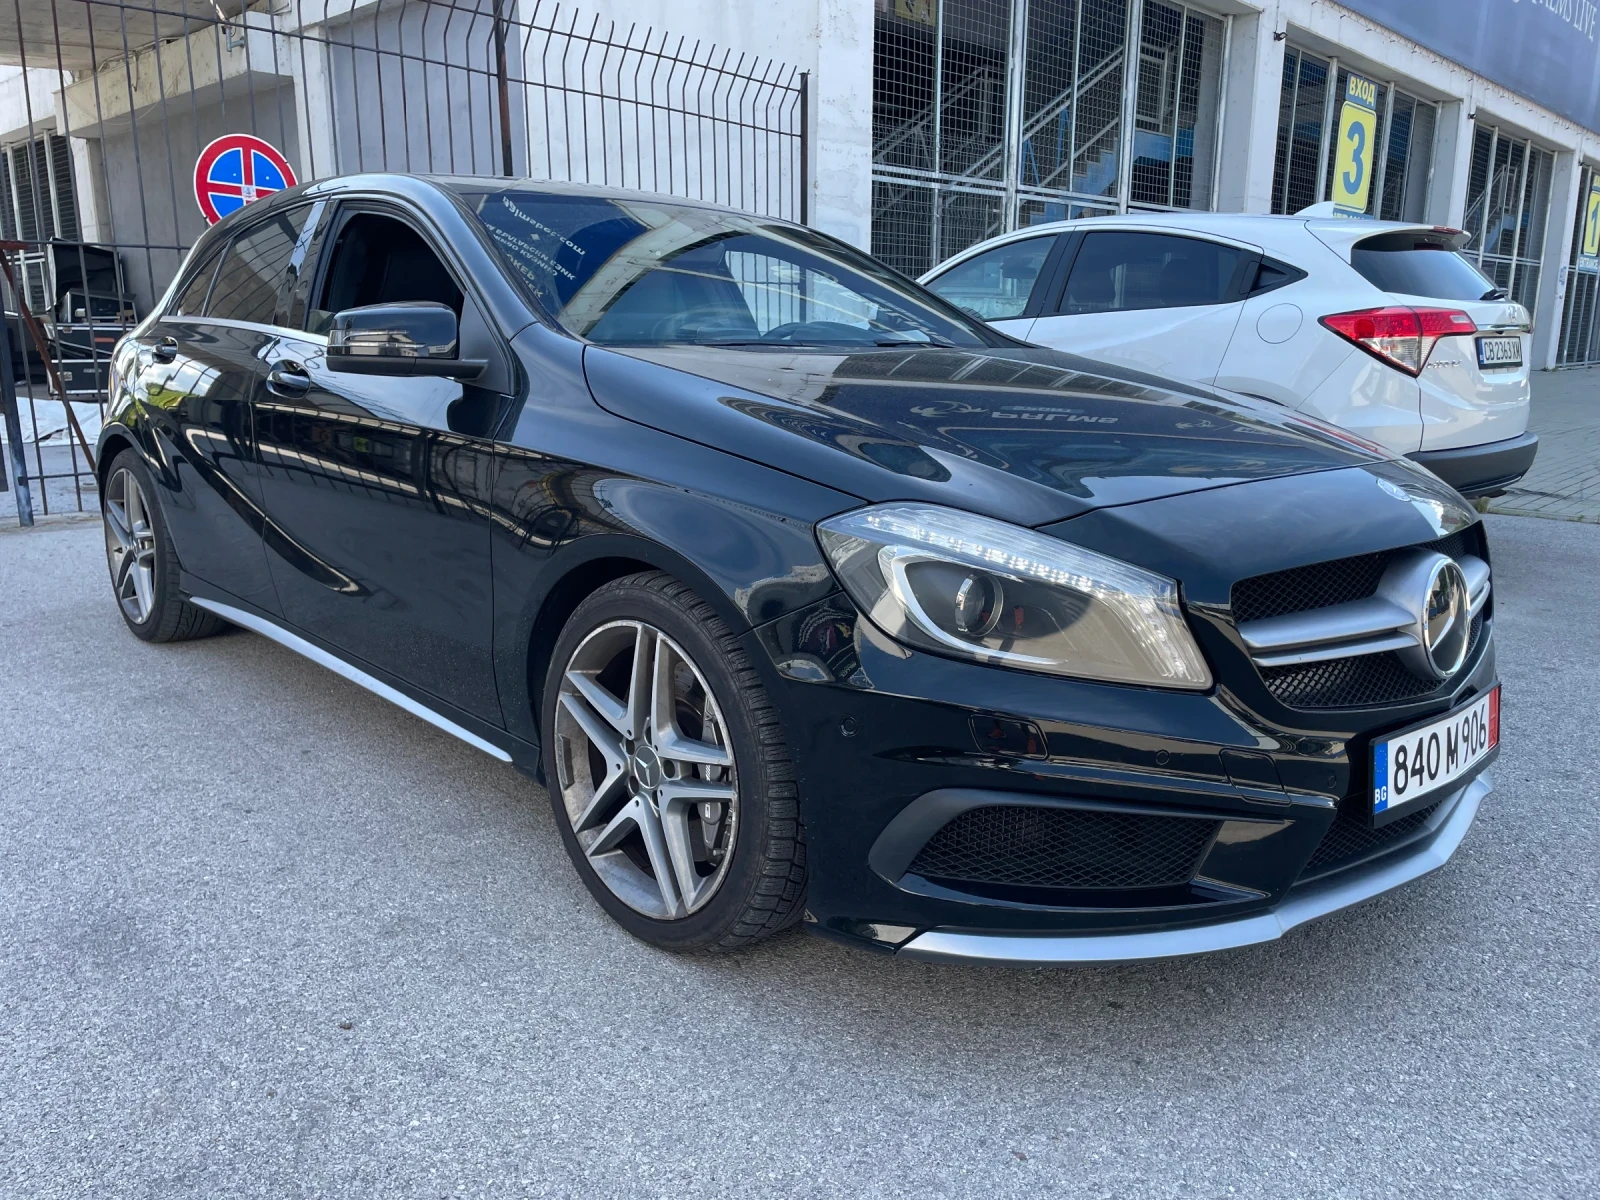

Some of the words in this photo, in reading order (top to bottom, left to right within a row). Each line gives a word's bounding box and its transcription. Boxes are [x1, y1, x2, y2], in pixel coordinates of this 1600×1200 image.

[1573, 0, 1597, 42] LIVE
[1349, 75, 1376, 107] ВХОД
[1342, 120, 1366, 195] 3
[1590, 200, 1600, 248] 1
[1495, 341, 1512, 360] 2363
[1393, 731, 1441, 796] 840
[1446, 721, 1459, 775] M
[1461, 702, 1487, 764] 906
[1374, 785, 1387, 805] BG
